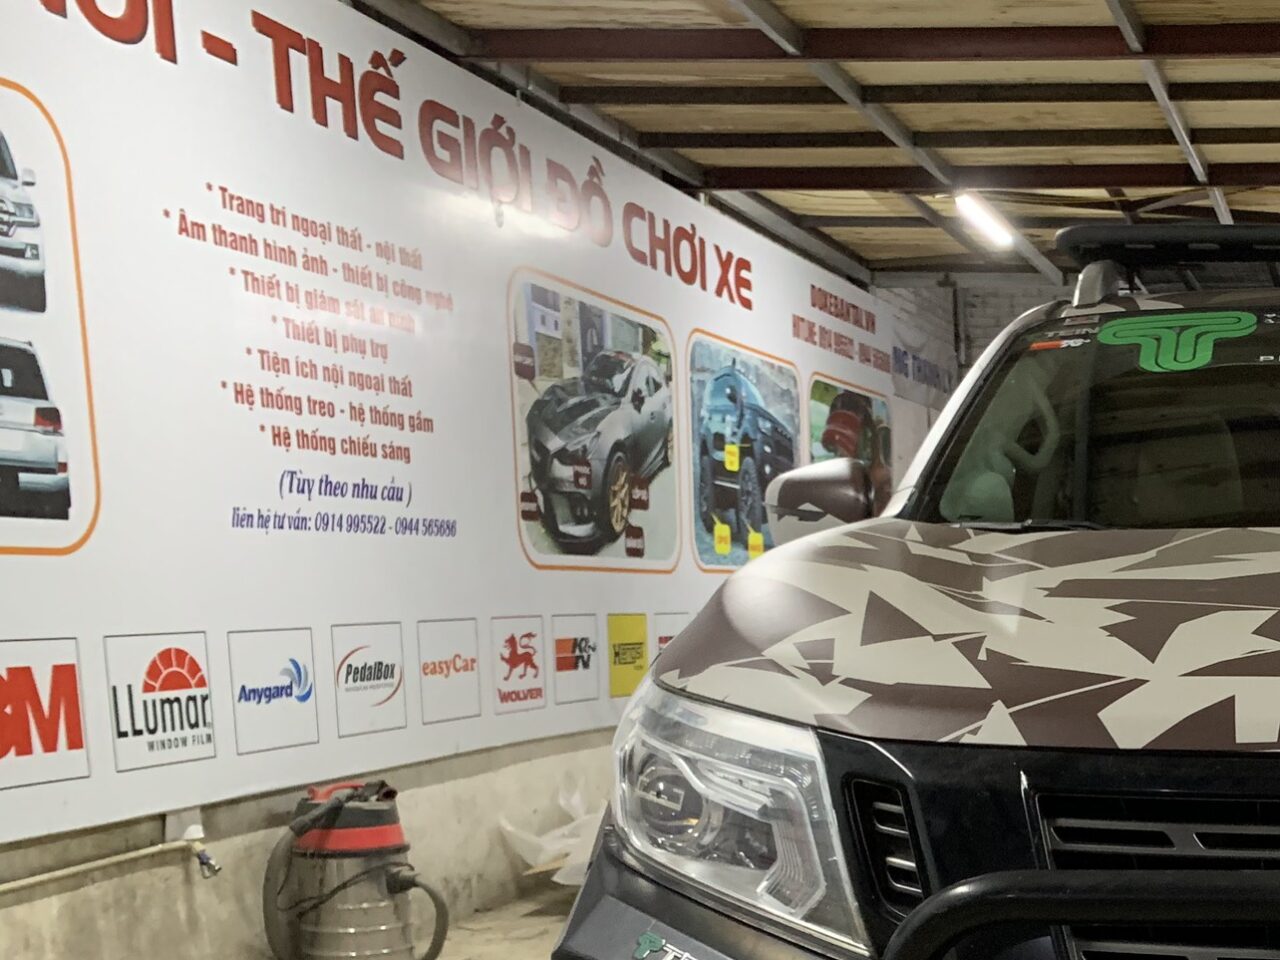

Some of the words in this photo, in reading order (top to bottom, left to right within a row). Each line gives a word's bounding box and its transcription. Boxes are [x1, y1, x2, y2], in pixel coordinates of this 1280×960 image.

[251, 10, 407, 160] THẾ
[622, 201, 707, 291] CHƠI
[713, 243, 754, 310] XE
[178, 208, 207, 242] Âm
[211, 223, 259, 257] thanh
[218, 185, 266, 224] Trang
[291, 213, 332, 245] ngoại
[240, 269, 282, 301] Thiết
[285, 281, 301, 309] bị
[282, 317, 321, 346] Thiết
[256, 348, 291, 378] Tiện
[294, 355, 318, 380] ích
[322, 363, 344, 389] nội
[348, 370, 385, 396] ngoại
[233, 382, 255, 411] Hệ
[259, 386, 303, 416] thống
[307, 394, 336, 418] treo
[348, 401, 366, 428] hệ
[369, 404, 405, 431] thống
[271, 425, 292, 453] Hệ
[295, 427, 337, 456] thống
[340, 434, 378, 459] chiếu
[381, 440, 412, 465] sáng
[279, 468, 316, 501] (Tùy
[318, 473, 348, 499] theo
[351, 477, 379, 500] nhu
[314, 511, 343, 533] 0914
[345, 513, 387, 535] 995522
[394, 516, 420, 536] 0944
[344, 661, 397, 685] PedalBox
[422, 653, 478, 679] easyCar
[238, 681, 294, 705] Anygard
[497, 686, 543, 704] WOLVER
[112, 684, 210, 739] LLumar
[147, 735, 188, 752] WINDOW
[191, 733, 213, 746] FILM
